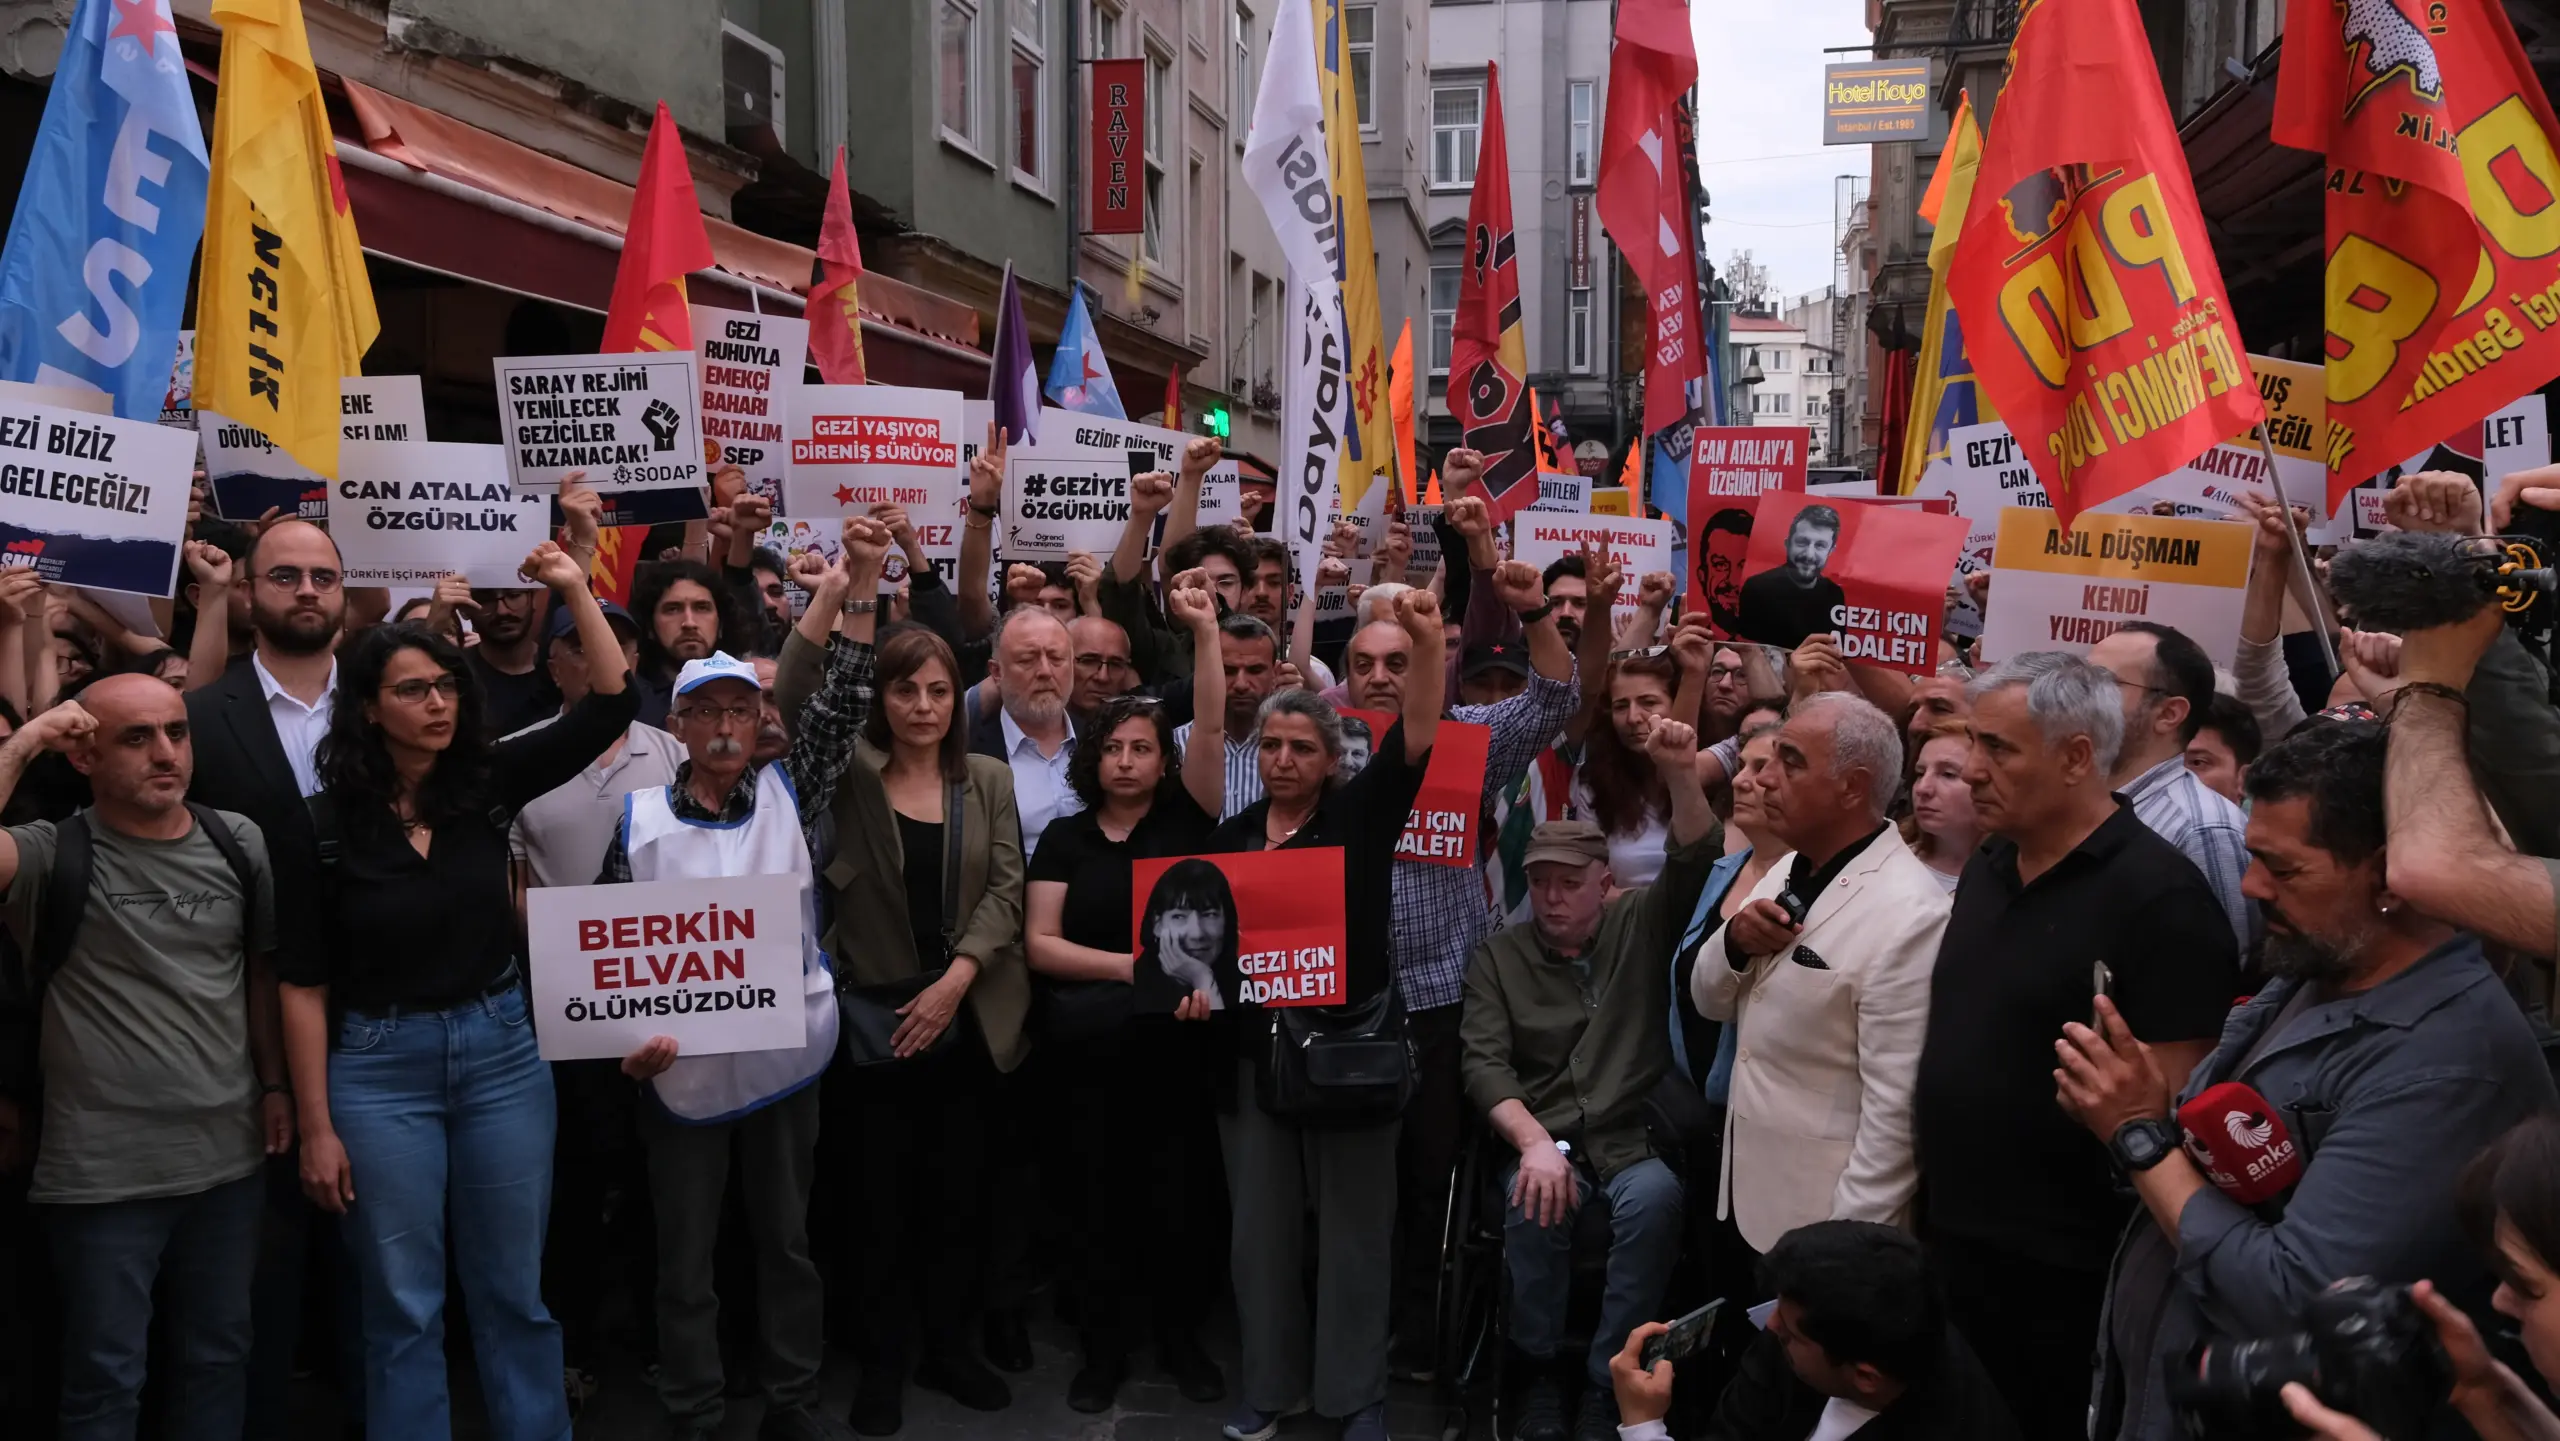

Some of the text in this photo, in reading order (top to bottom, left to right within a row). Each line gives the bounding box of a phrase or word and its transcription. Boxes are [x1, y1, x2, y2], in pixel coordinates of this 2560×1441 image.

[1828, 79, 1926, 104] Hotel Kaya
[1107, 84, 1129, 209] RAVEN
[725, 320, 761, 342] GEZİ
[705, 340, 781, 367] RUHUYLA
[510, 367, 648, 395] SARAY REJİMİ
[705, 365, 771, 395] EMEKÇİ
[513, 394, 621, 420] YENİLECEK
[702, 390, 769, 417] BAHARI
[518, 419, 616, 445] GEZİCİLER
[815, 416, 940, 440] GEZİ YAŞIYOR
[2484, 415, 2525, 449] LET
[47, 421, 116, 463] BİZİZ
[794, 440, 955, 463] DİRENİŞ SÜRÜYOR
[1697, 439, 1795, 466] CAN ATALAY'A
[522, 444, 649, 468] KAZANACAK!
[723, 446, 764, 466] SEP
[634, 465, 698, 483] SODAP
[1024, 472, 1126, 497] #GEZİYE
[2000, 468, 2030, 489] CAN
[0, 464, 151, 515] GELECEĞİZ!
[339, 481, 400, 500] CAN
[2359, 495, 2378, 508] CAN
[366, 506, 518, 532] ÖZGÜRLÜK
[1021, 500, 1131, 521] ÖZGÜRLÜK
[1017, 539, 1065, 549] Dayanışması
[1535, 527, 1600, 544] HALKIN
[1608, 530, 1656, 547] VEKİLİ
[2044, 526, 2200, 571] ASIL DÜŞMAN
[343, 568, 456, 580] TÜRKİYE İŞÇİ PARTİS
[2082, 584, 2148, 616] KENDİ
[1830, 604, 1928, 638] GEZİ İÇİN
[1425, 809, 1466, 833] İÇİN
[1394, 832, 1464, 858] ALET!
[578, 903, 755, 951] BERKİN
[594, 948, 745, 990] ELVAN
[1238, 945, 1335, 975] GEZİ İÇİN
[1238, 971, 1336, 1005] ADALET!
[564, 984, 776, 1022] ÖLÜMSÜZDÜR
[2246, 1139, 2294, 1177] anka
